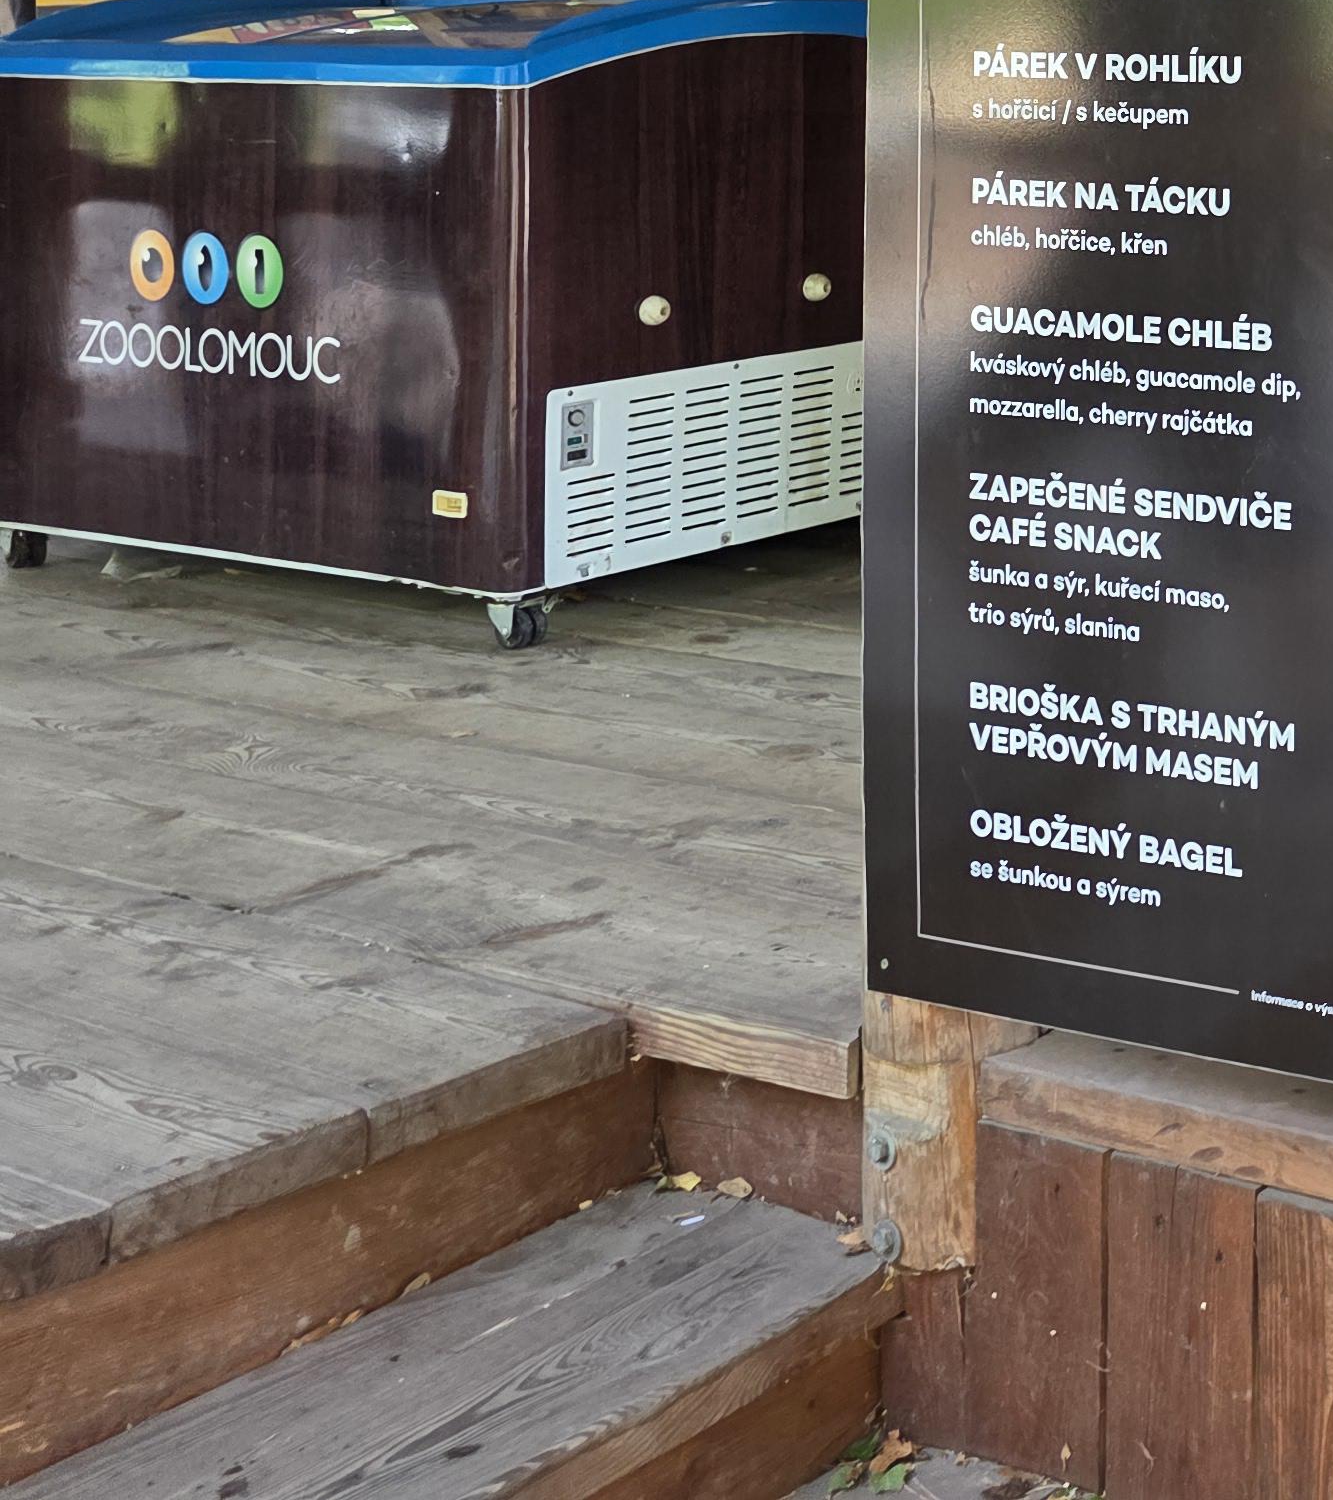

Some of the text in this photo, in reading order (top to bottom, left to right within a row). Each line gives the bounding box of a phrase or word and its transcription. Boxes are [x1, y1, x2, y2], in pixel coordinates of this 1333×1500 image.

[974, 44, 1241, 84] PÁREK V ROHLÍKU
[1094, 101, 1188, 129] kečupem
[972, 171, 1230, 216] PÁREK NA TÁCKU
[971, 224, 1115, 255] chléb, hořčice,
[78, 319, 340, 384] ZOOOLOMOUC
[1136, 370, 1300, 402] guacamole dip,
[1089, 402, 1252, 436] cherry rajčátka
[970, 810, 1242, 877] OBLOŽENÝ BAGEL
[1096, 878, 1160, 906] sýrem
